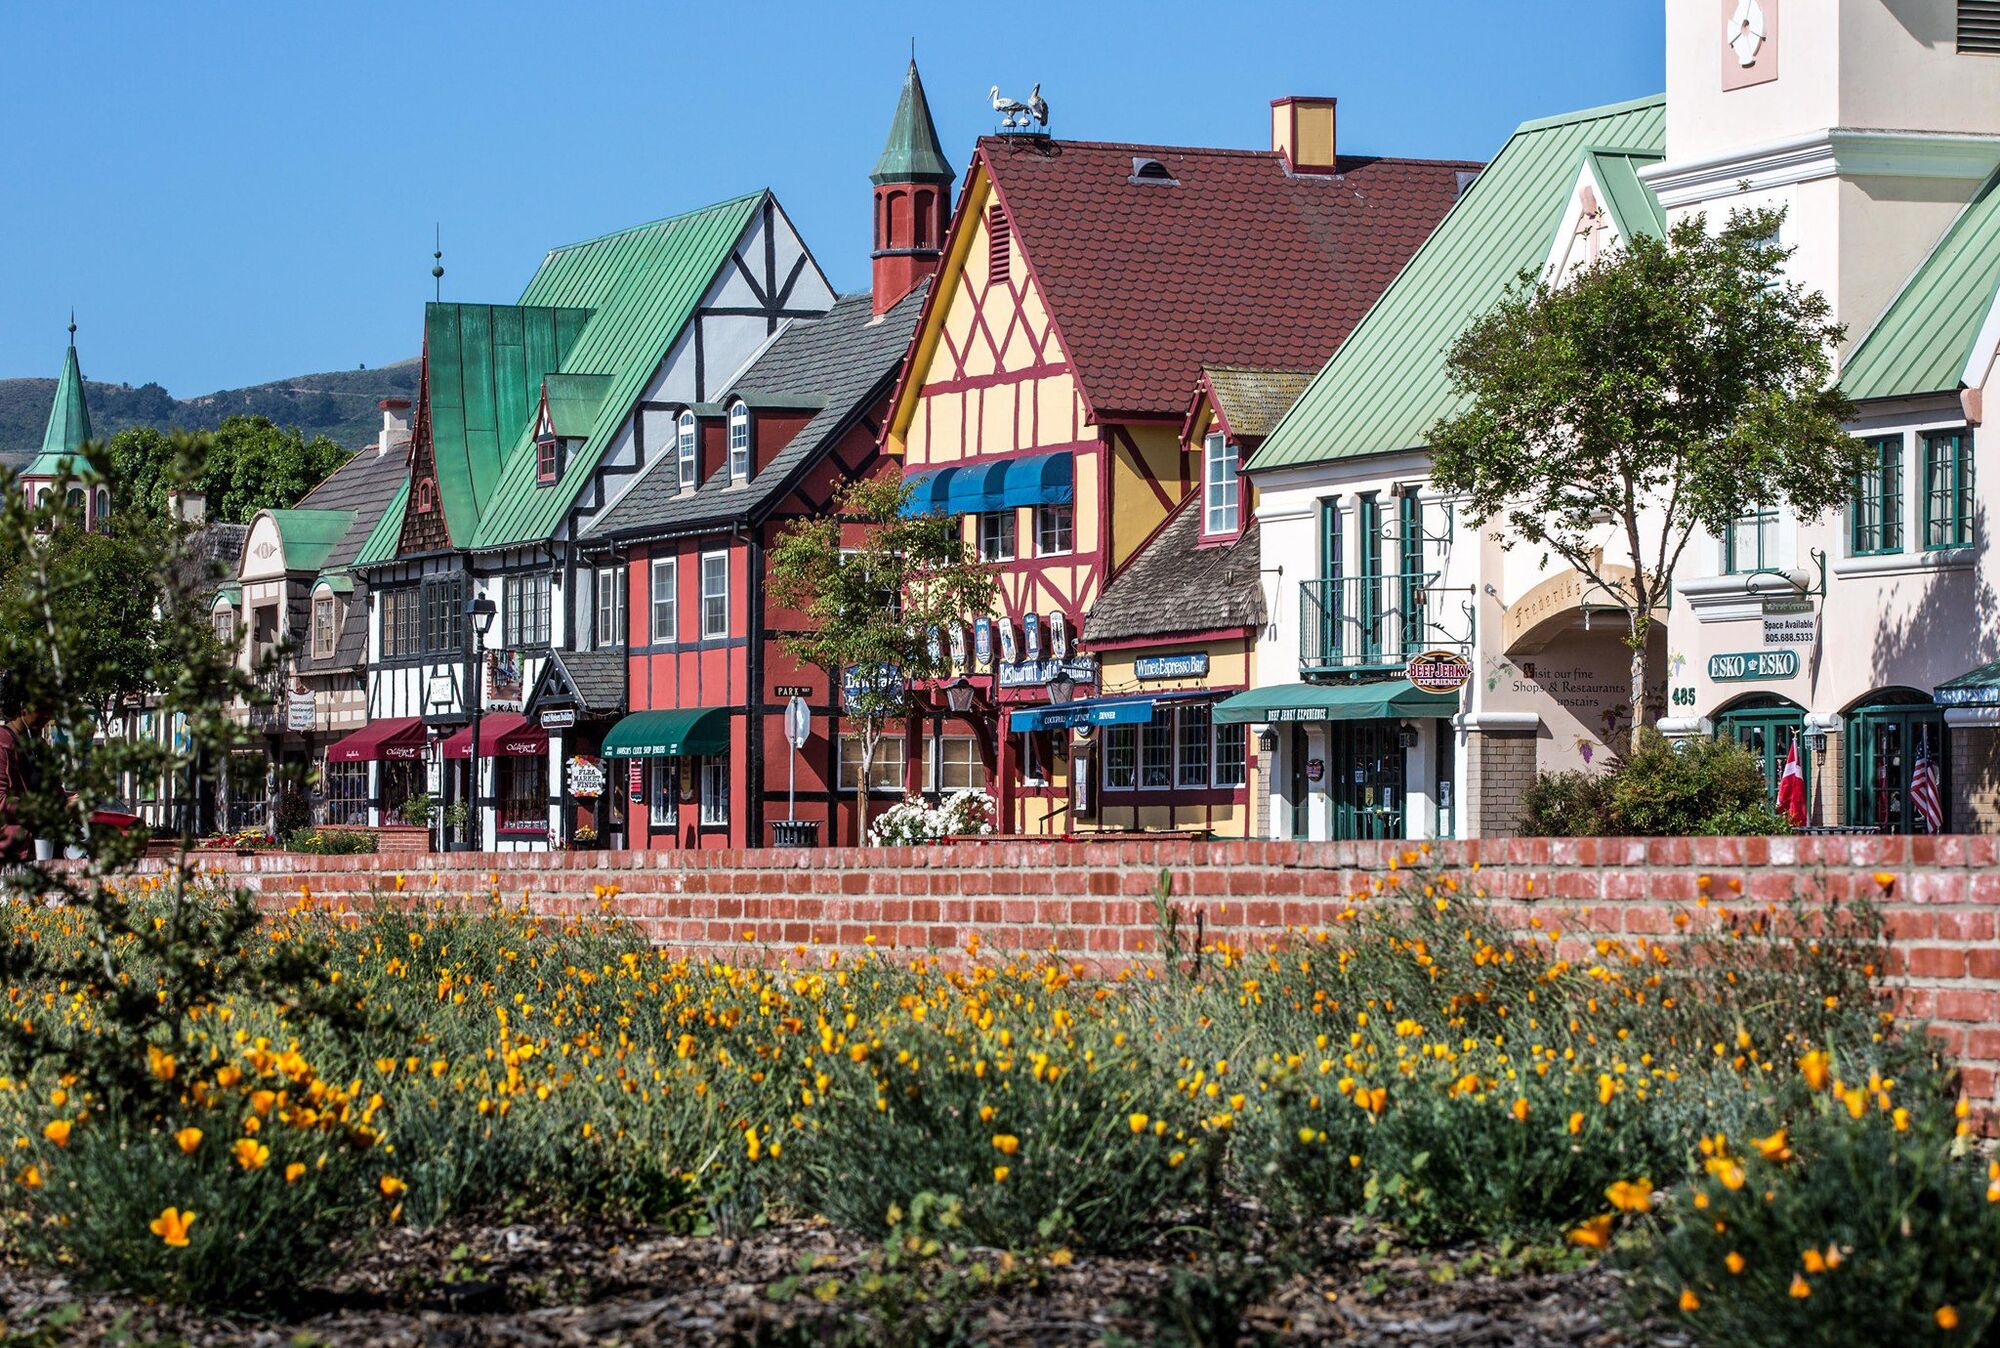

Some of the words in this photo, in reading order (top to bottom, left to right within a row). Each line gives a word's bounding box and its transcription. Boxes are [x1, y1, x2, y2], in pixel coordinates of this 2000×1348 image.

[1764, 621, 1784, 632] Space
[1785, 619, 1813, 629] Available
[1765, 633, 1813, 643] 805.688.5333
[1190, 656, 1204, 673] Bar
[1409, 663, 1434, 677] BEEF
[1435, 662, 1470, 678] JERKY
[1711, 655, 1745, 678] ESKO
[1759, 653, 1794, 675] ESKO
[1554, 670, 1572, 679] our
[1573, 667, 1593, 681] fine
[778, 687, 799, 696] PARK
[1512, 680, 1545, 694] Shops
[1548, 682, 1558, 692] &
[1561, 681, 1626, 693] Restaurants
[1557, 696, 1599, 707] upstairs
[1672, 687, 1696, 706] 485
[490, 702, 520, 713] SKÅL
[1099, 711, 1116, 719] DINNER
[1268, 709, 1280, 721] BEEF
[1281, 709, 1296, 720] JERKY
[1297, 708, 1326, 720] EXPERIENCE
